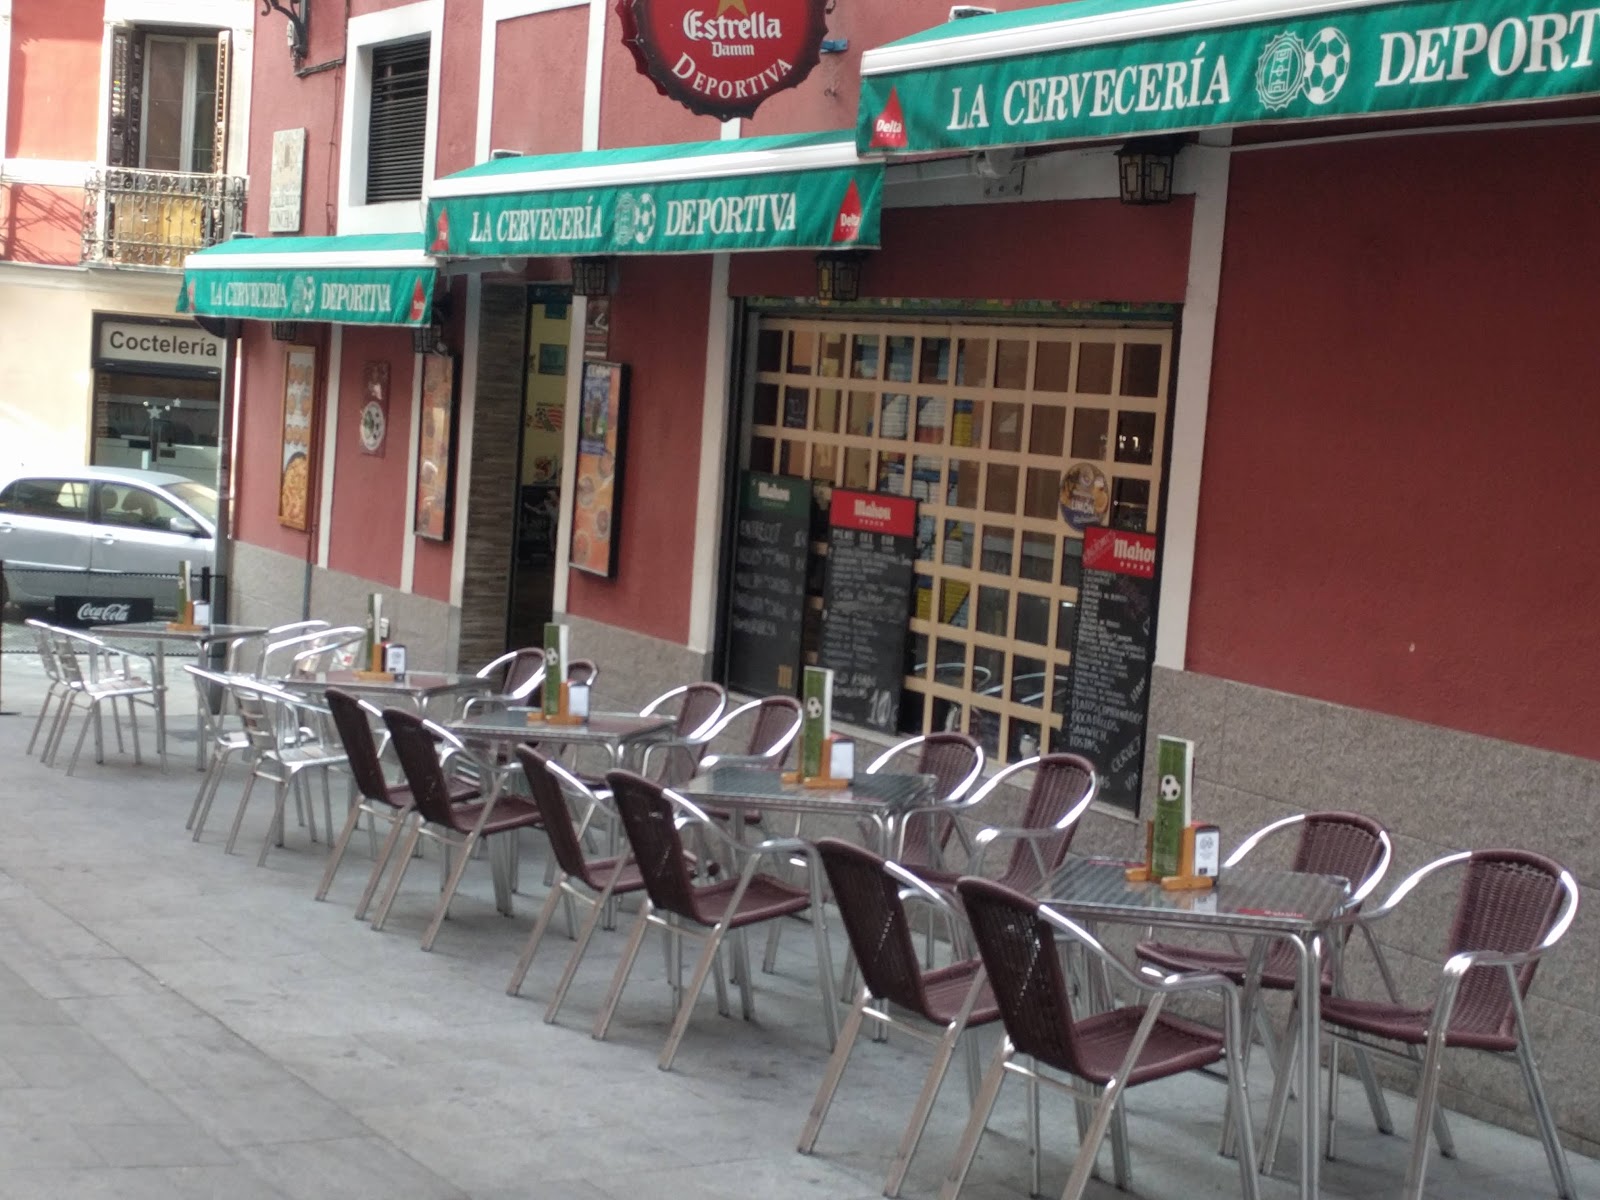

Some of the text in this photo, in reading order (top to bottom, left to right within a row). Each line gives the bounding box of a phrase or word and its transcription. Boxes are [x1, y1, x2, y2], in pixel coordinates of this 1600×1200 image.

[682, 9, 782, 41] Estrella
[711, 41, 755, 58] Damm
[671, 52, 793, 99] DEPORTIVA
[946, 84, 990, 131] LA
[1003, 41, 1232, 126] CERVECERÍA
[875, 119, 903, 133] Delta
[469, 192, 797, 243] LA CERVECERÍA DEPORTIVA
[210, 275, 393, 313] LA CERVECERÍA DEPORTIVA
[109, 330, 218, 358] Coctelería
[854, 499, 891, 521] Mahou
